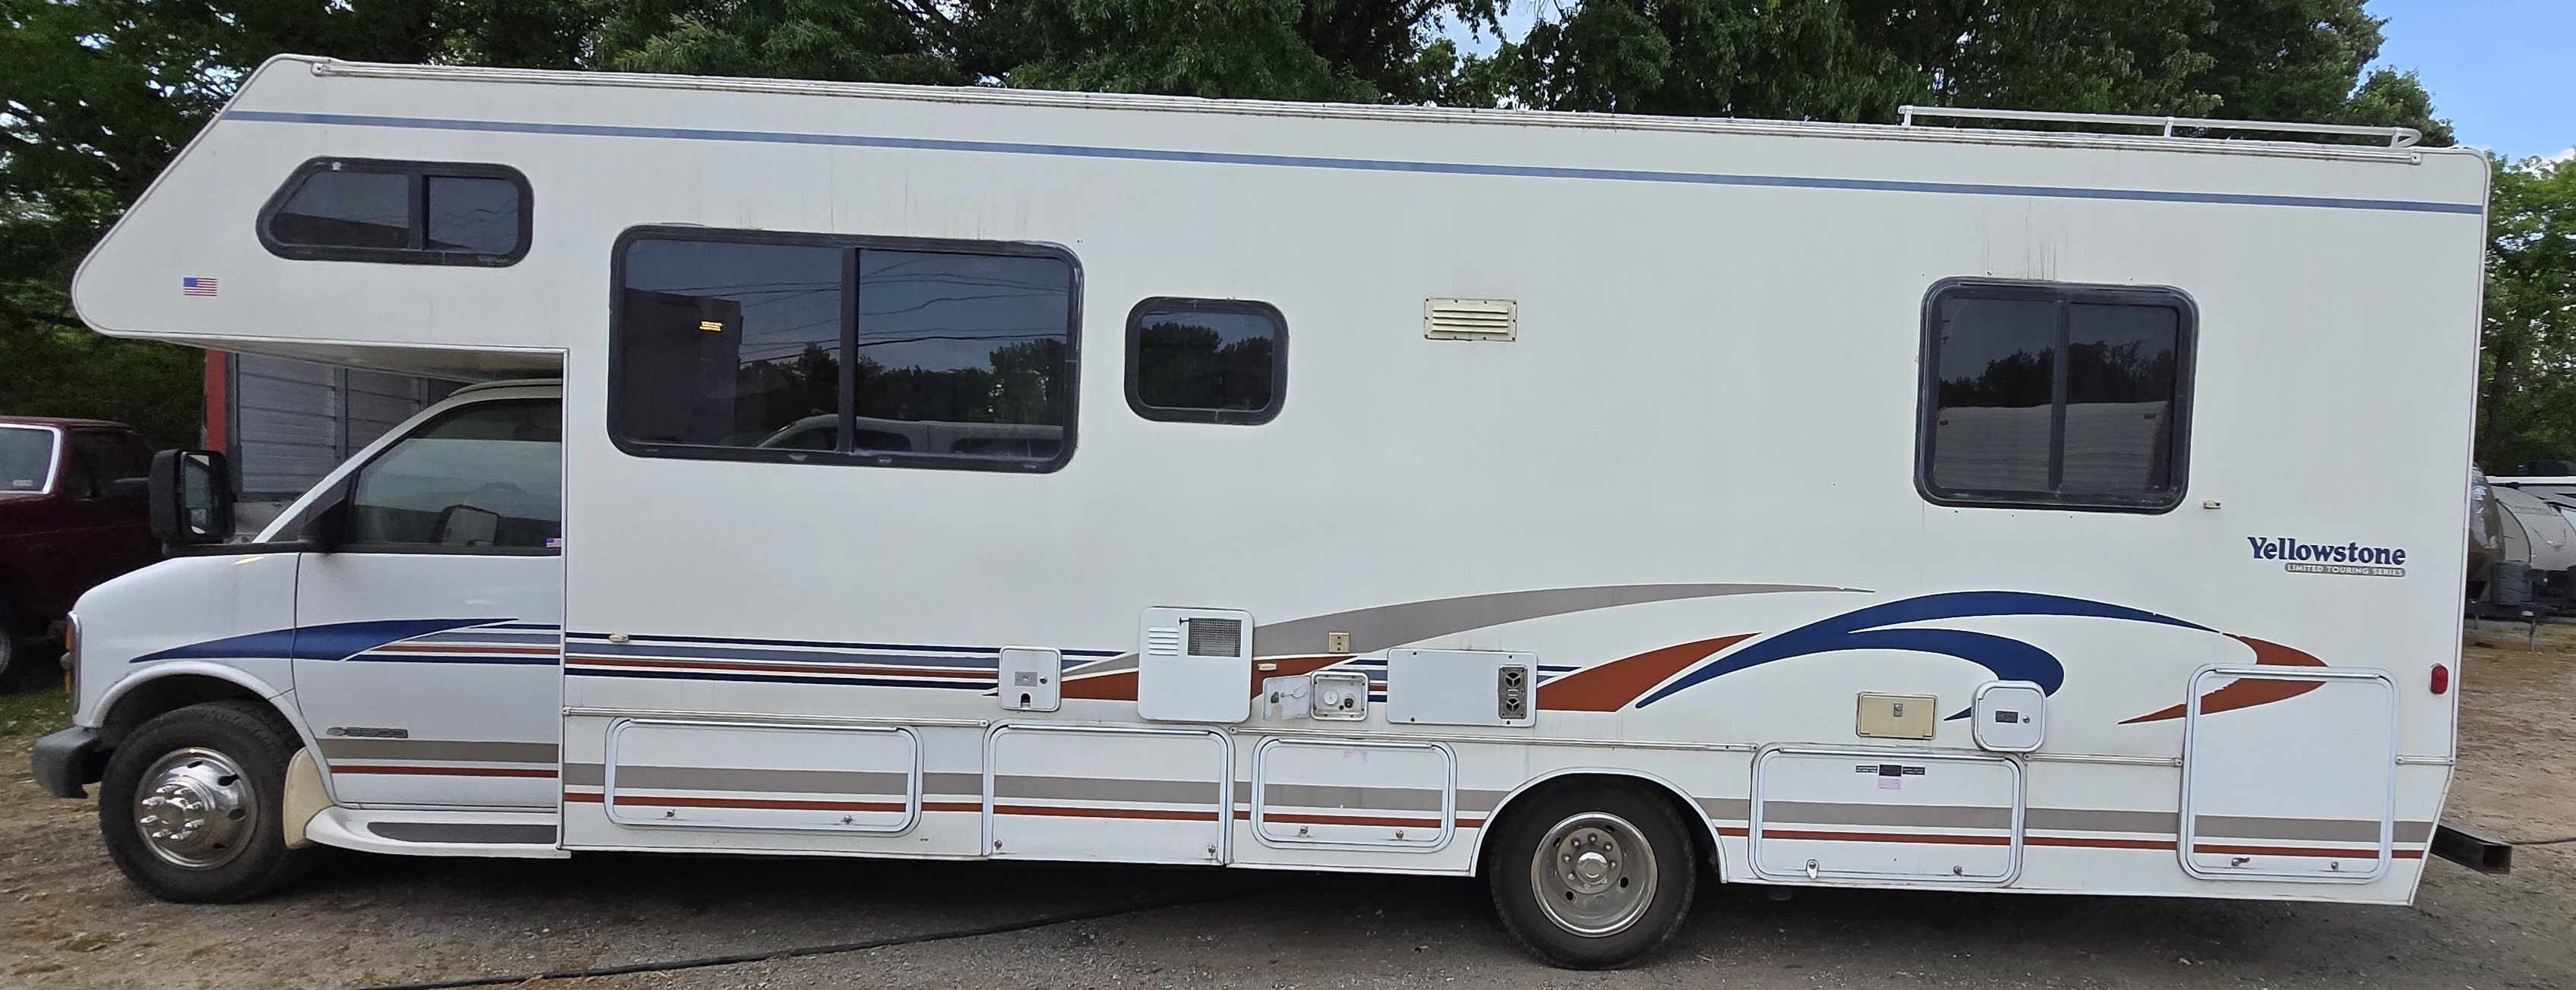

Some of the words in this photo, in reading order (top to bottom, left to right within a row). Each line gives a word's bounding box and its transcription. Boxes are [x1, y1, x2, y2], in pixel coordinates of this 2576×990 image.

[2247, 537, 2406, 565] Yellowstone
[2287, 564, 2324, 572] LIMITED
[2327, 566, 2369, 575] TOURING
[2372, 568, 2403, 576] SERIES
